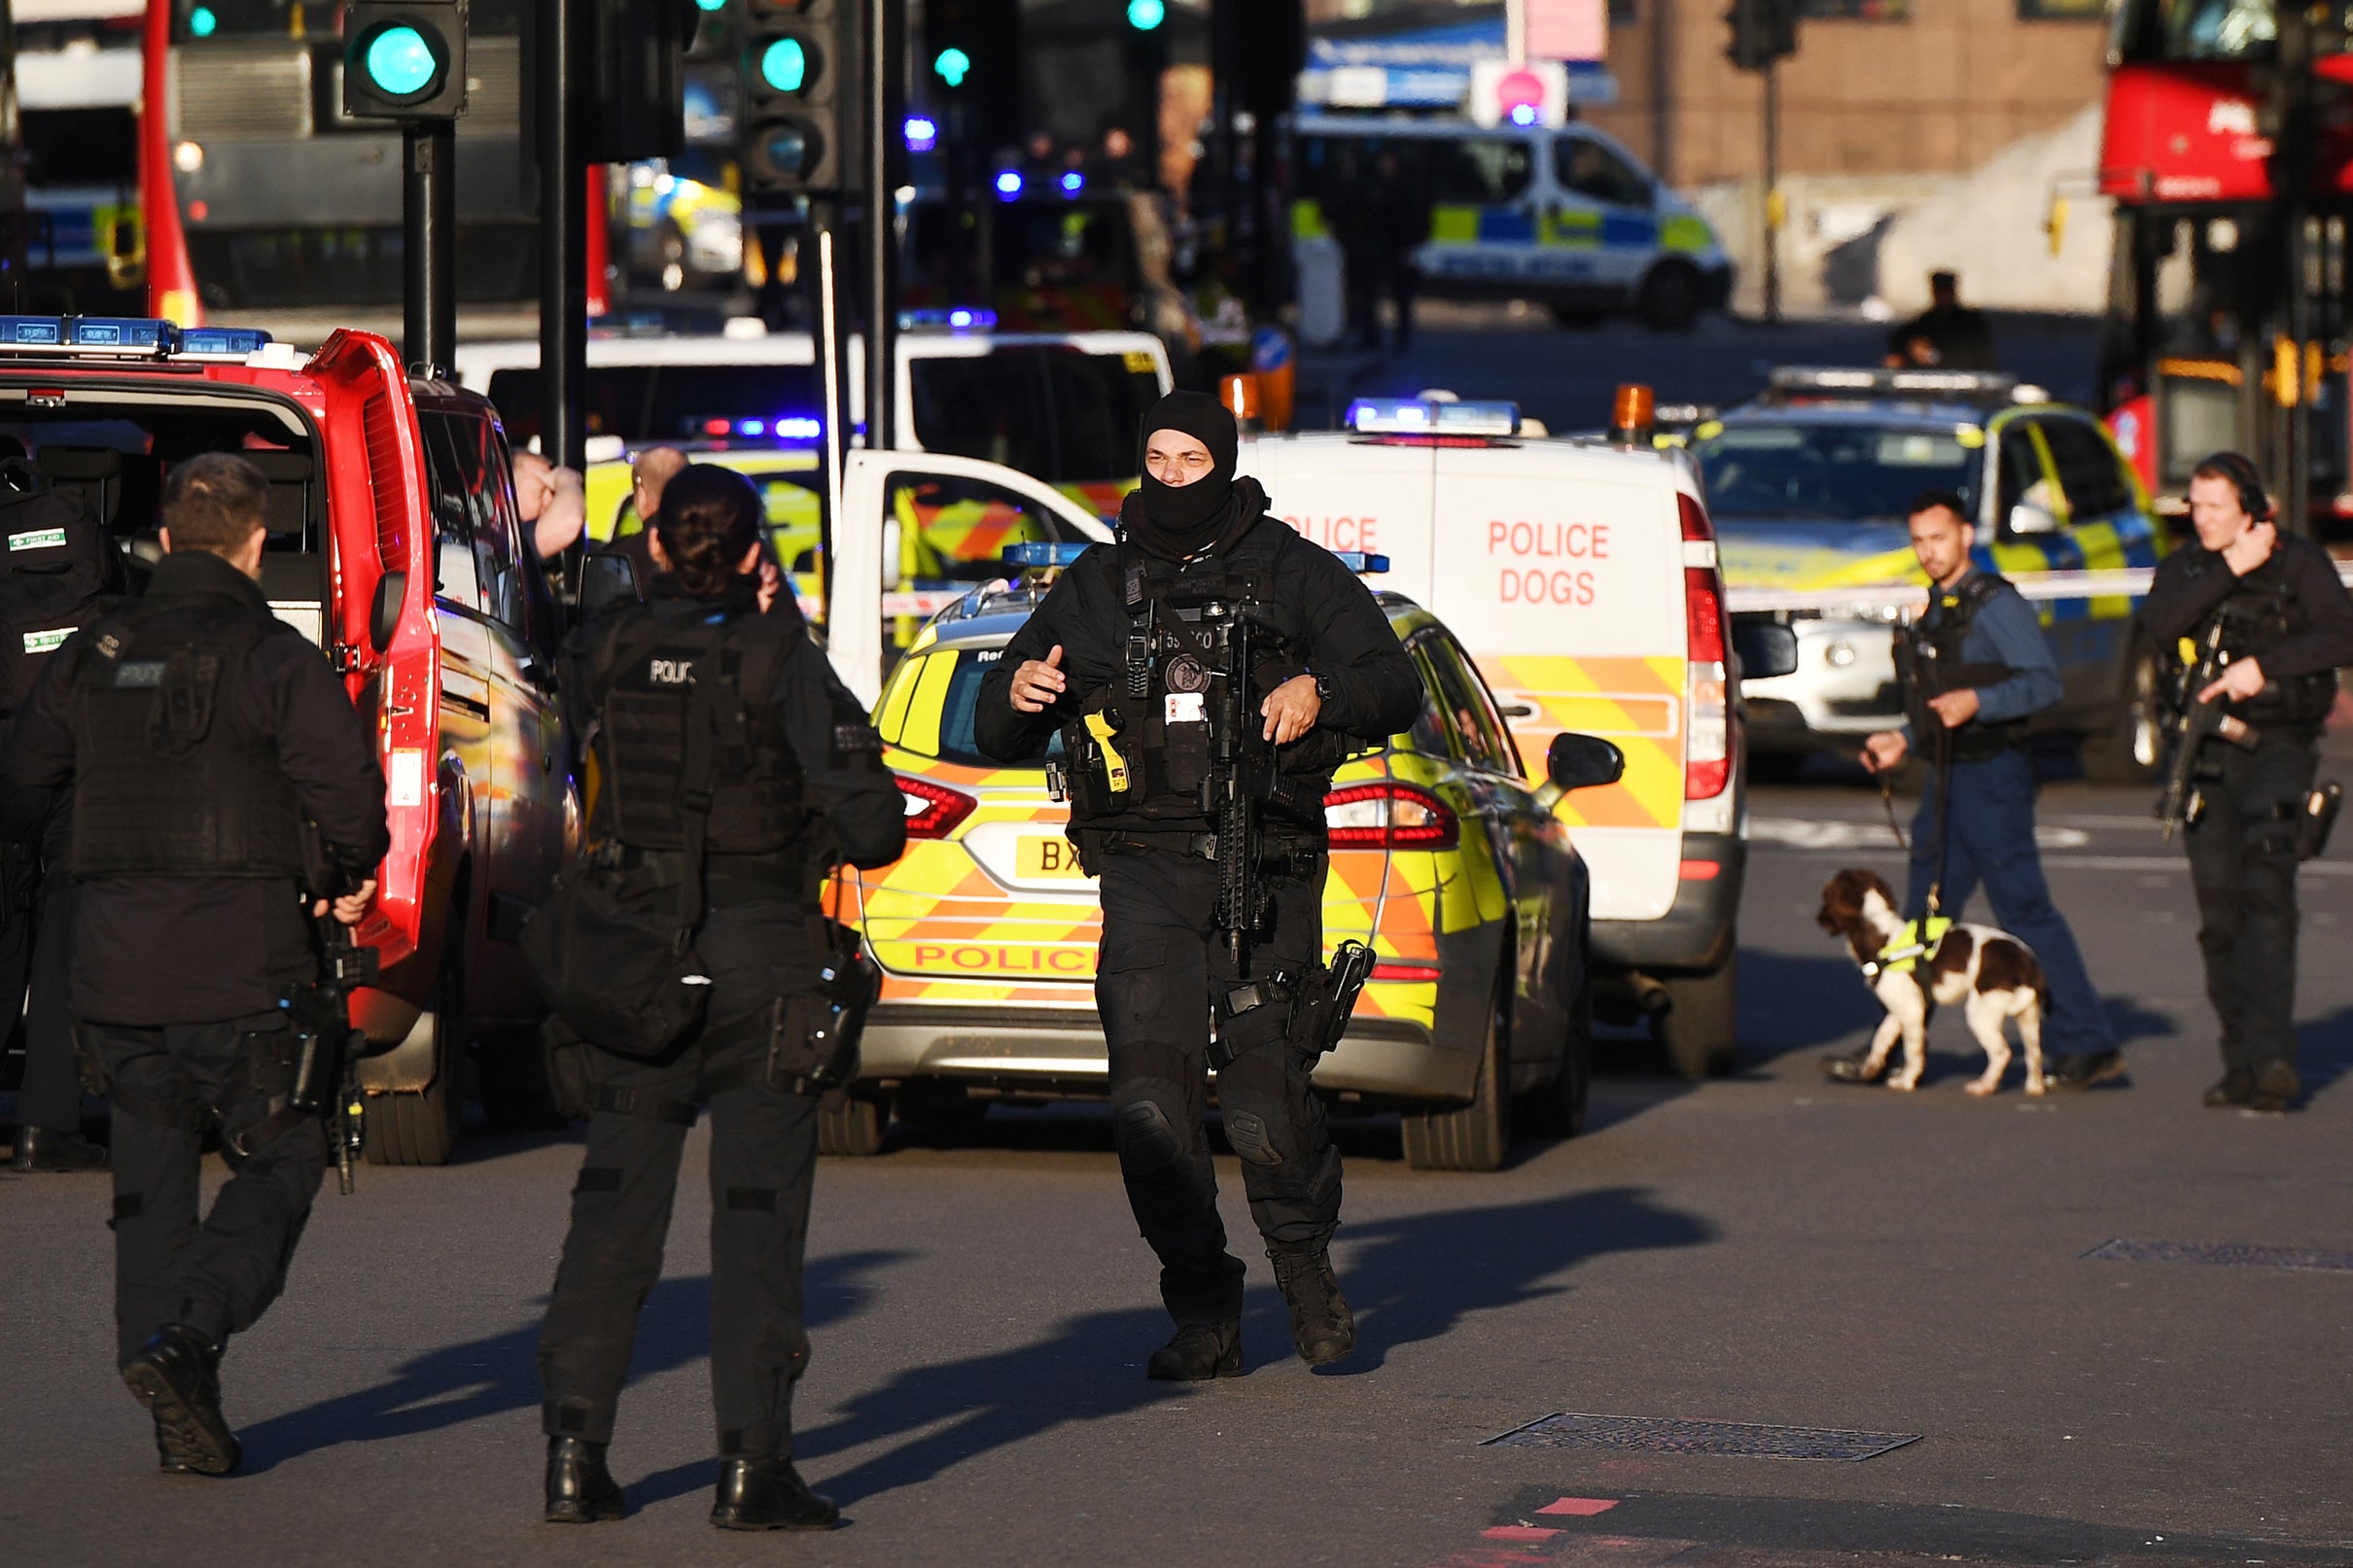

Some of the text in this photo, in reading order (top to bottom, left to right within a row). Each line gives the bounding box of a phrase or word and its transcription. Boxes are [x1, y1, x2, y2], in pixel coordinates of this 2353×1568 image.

[1282, 516, 1377, 552] LICE
[1489, 521, 1608, 558] POLICE
[1500, 569, 1595, 606] DOGS
[650, 659, 697, 683] POLIC
[1041, 841, 1082, 870] BX
[915, 946, 1099, 971] POLIC
